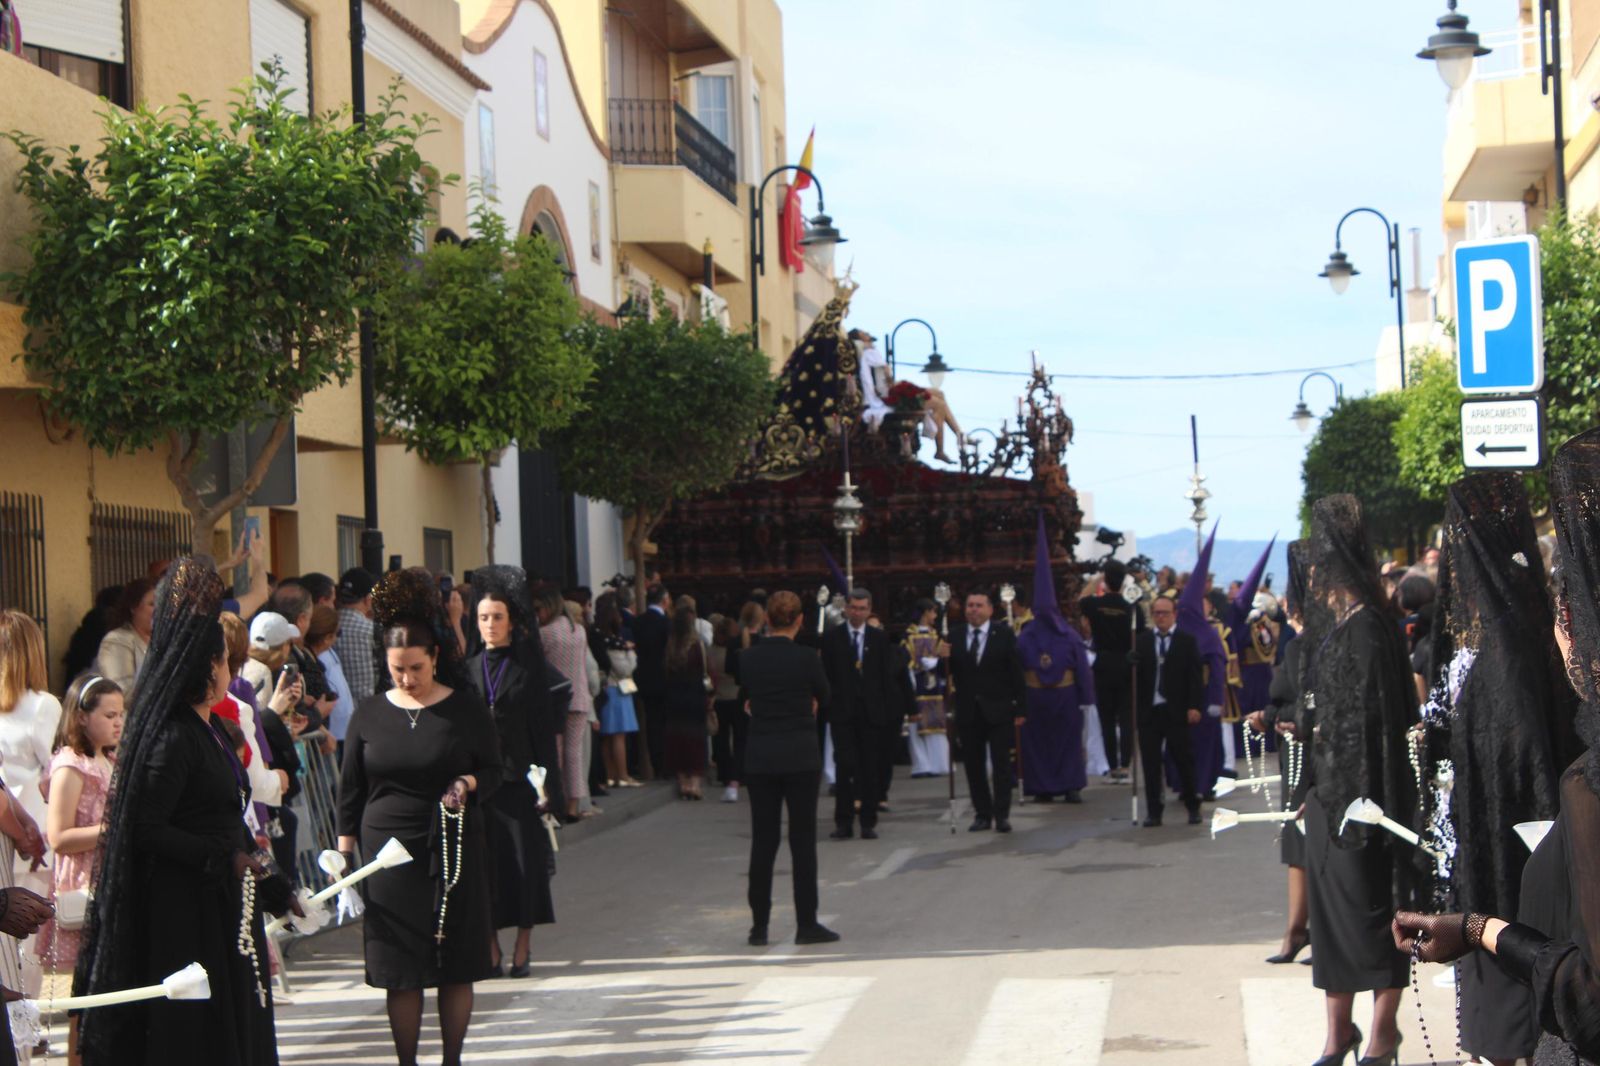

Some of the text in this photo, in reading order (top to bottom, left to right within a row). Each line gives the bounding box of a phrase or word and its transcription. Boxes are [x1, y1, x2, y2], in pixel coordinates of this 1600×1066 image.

[1469, 258, 1518, 374] P
[1471, 407, 1527, 418] APARCAMIENTO
[1465, 423, 1535, 435] CIUDAD DEPORTIVA
